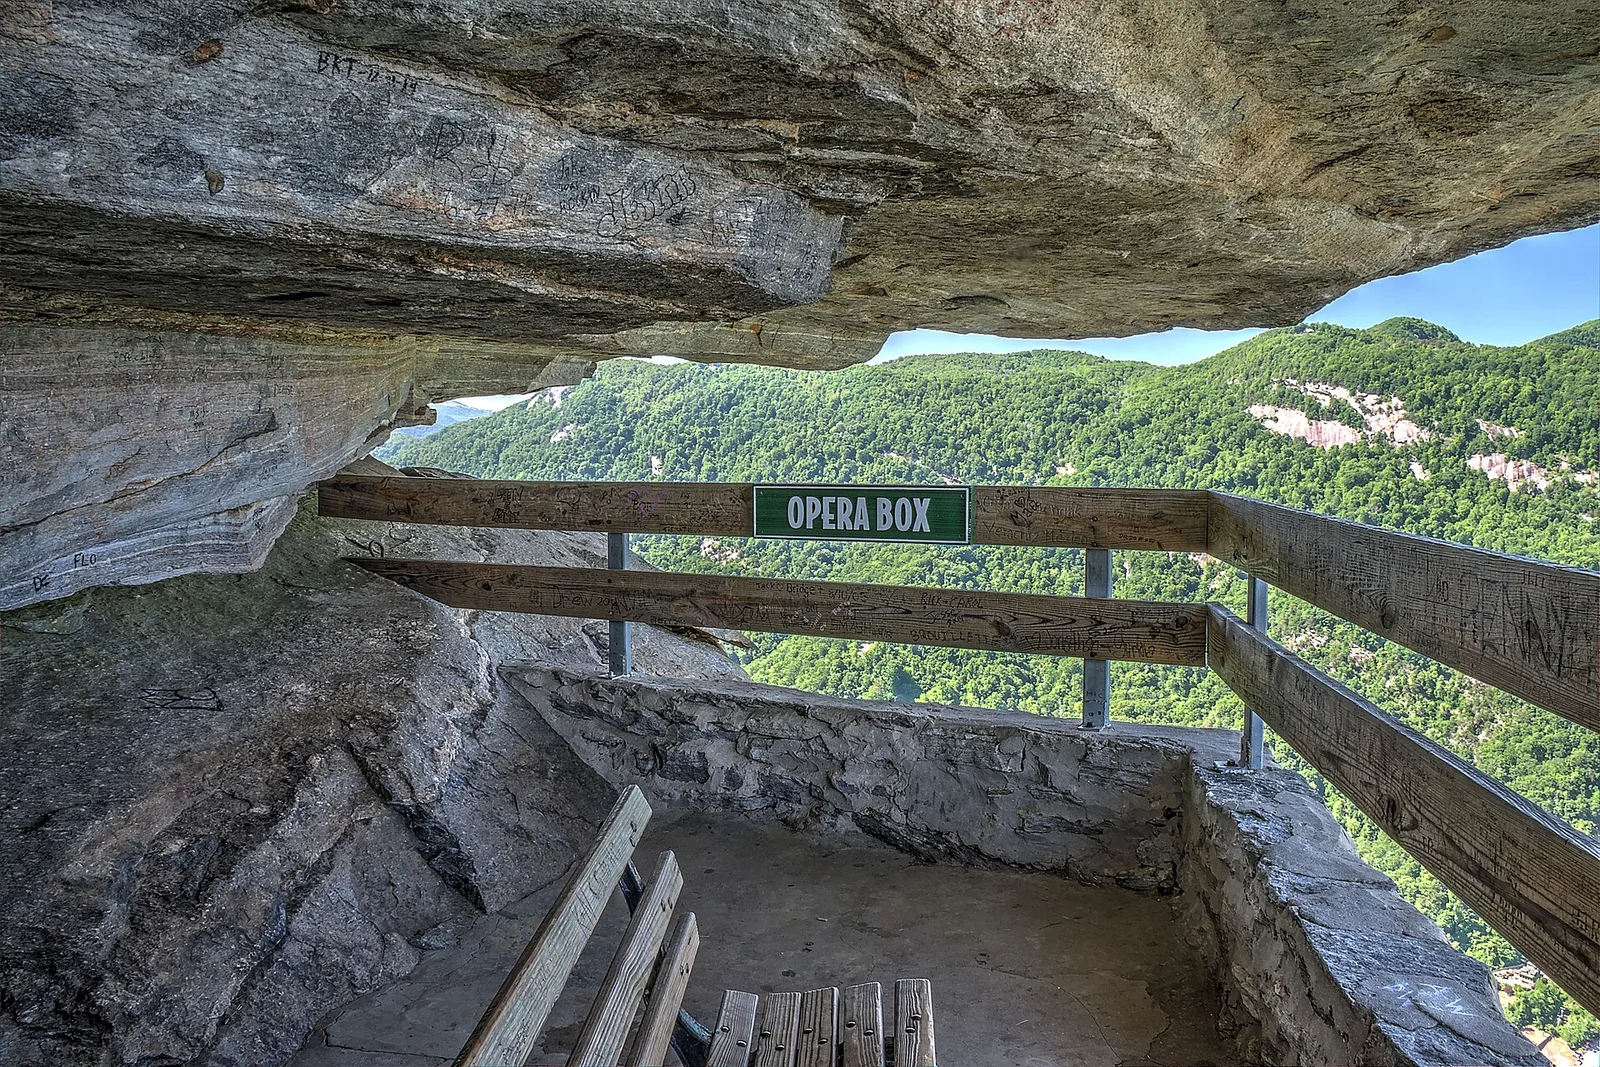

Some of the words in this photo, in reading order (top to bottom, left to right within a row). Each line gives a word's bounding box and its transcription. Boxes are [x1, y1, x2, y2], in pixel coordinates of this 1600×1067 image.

[787, 495, 870, 531] OPERA
[876, 497, 931, 533] BOX
[74, 552, 97, 569] FLO
